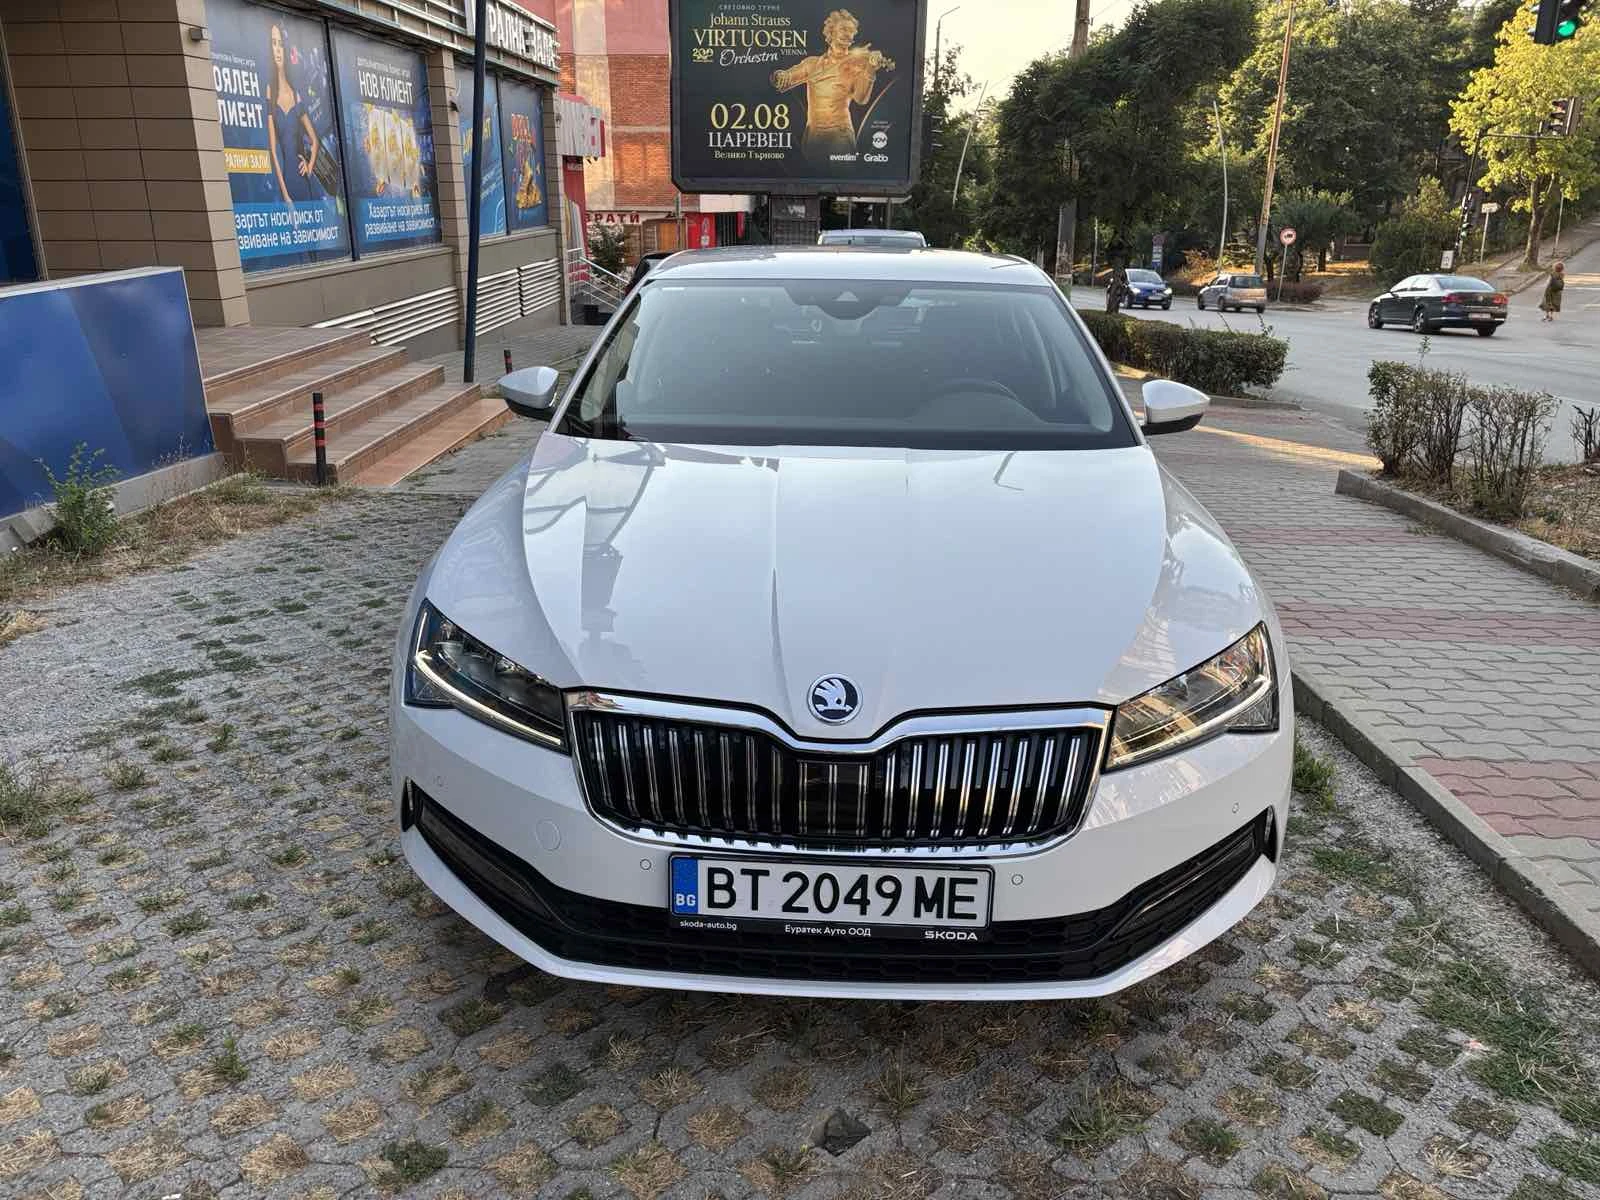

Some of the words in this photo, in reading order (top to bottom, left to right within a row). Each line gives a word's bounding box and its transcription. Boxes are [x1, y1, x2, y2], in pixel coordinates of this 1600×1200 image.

[710, 12, 749, 28] Johann
[751, 13, 792, 26] Strauss
[692, 28, 808, 48] VIRTUOSEN
[719, 47, 779, 67] Orchestra
[780, 48, 808, 56] VIENNA
[212, 65, 260, 98] ОЯЛЕН
[358, 70, 380, 99] НОВ
[379, 75, 413, 105] КЛИЕНТ
[217, 99, 264, 129] ЛИЕНТ
[710, 103, 790, 130] 02.08
[708, 132, 793, 150] ЦАРЕВЕЦ
[714, 150, 746, 159] Велико
[748, 150, 785, 161] Търново
[829, 153, 857, 161] eventim
[863, 152, 889, 162] Grabo
[234, 212, 268, 233] зартът
[270, 211, 293, 227] носи
[293, 210, 313, 230] риск
[314, 209, 324, 223] от
[238, 231, 279, 250] звиване
[280, 231, 292, 245] на
[292, 225, 339, 245] зависимост
[675, 893, 697, 906] BG
[707, 866, 770, 912] BT
[781, 870, 903, 917] 2049
[913, 875, 979, 920] ME
[679, 920, 738, 931] skoda-auto.bg
[784, 924, 823, 935] Еуратек
[823, 926, 847, 937] Ауто
[848, 928, 872, 937] ООД
